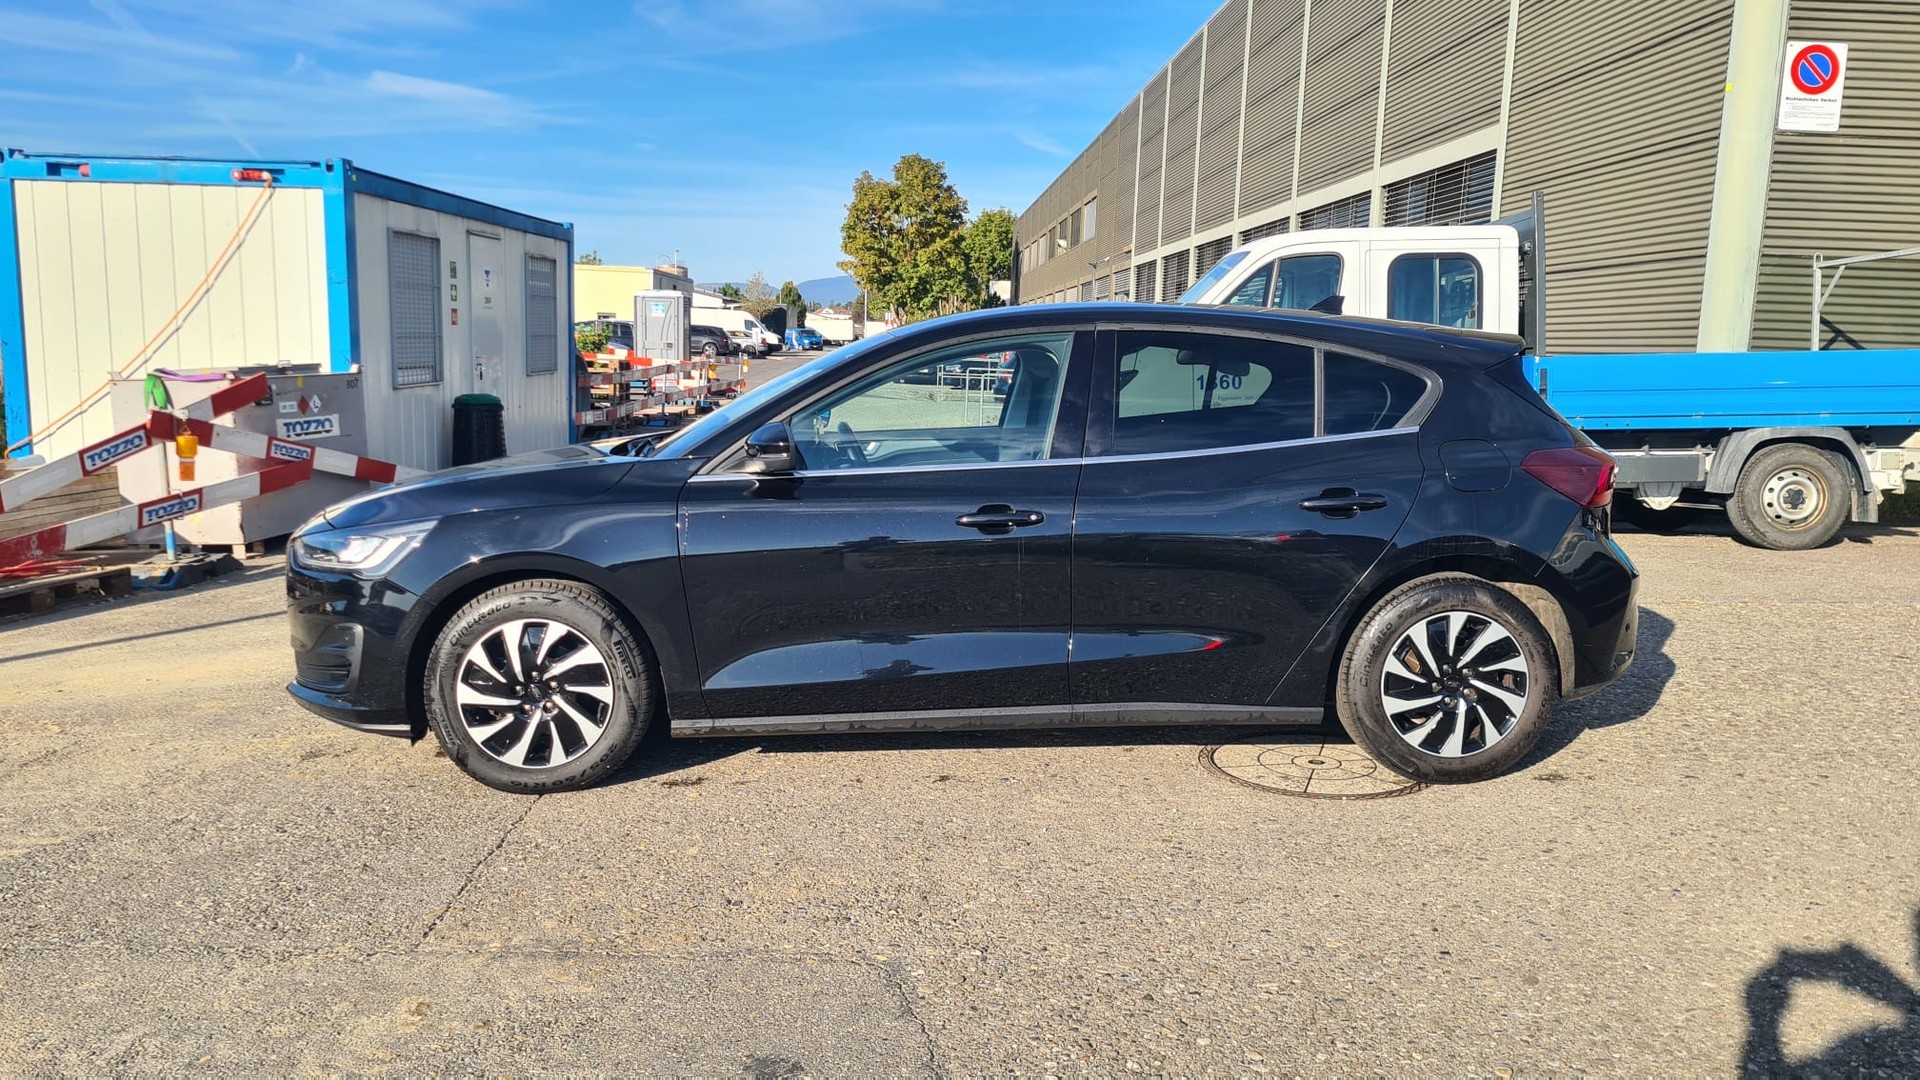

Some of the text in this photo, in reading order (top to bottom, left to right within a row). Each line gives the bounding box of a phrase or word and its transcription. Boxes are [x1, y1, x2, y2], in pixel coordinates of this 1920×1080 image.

[283, 417, 334, 438] TOZZO
[86, 434, 143, 467] TOZZO
[273, 443, 309, 460] TOZZO
[145, 498, 197, 522] TOZZO
[612, 639, 636, 679] PIRELLI
